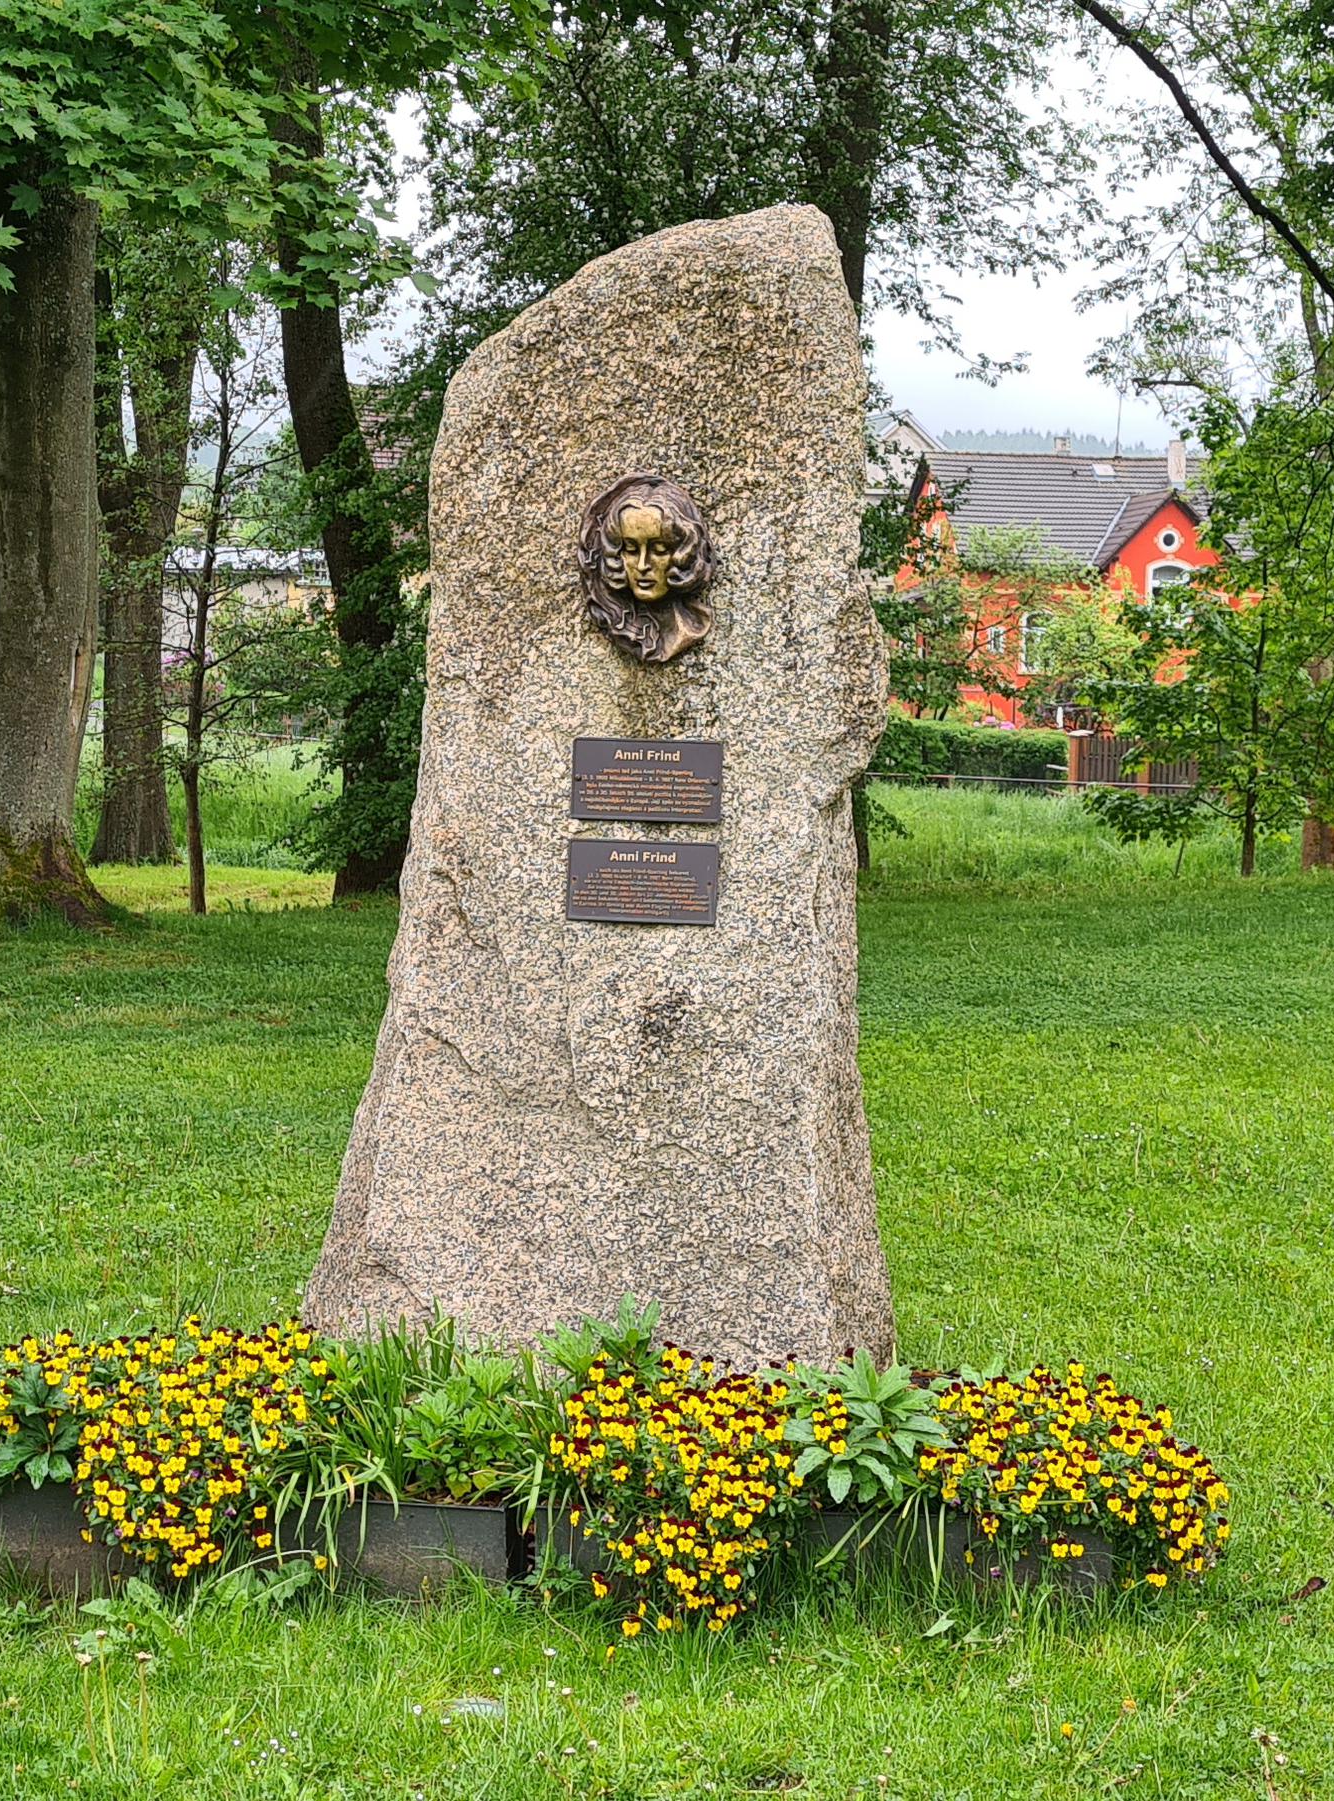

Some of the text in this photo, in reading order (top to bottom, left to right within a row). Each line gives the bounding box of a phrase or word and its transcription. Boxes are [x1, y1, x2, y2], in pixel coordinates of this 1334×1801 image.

[613, 748, 681, 762] Anni Frind
[609, 850, 677, 864] Anni Frind
